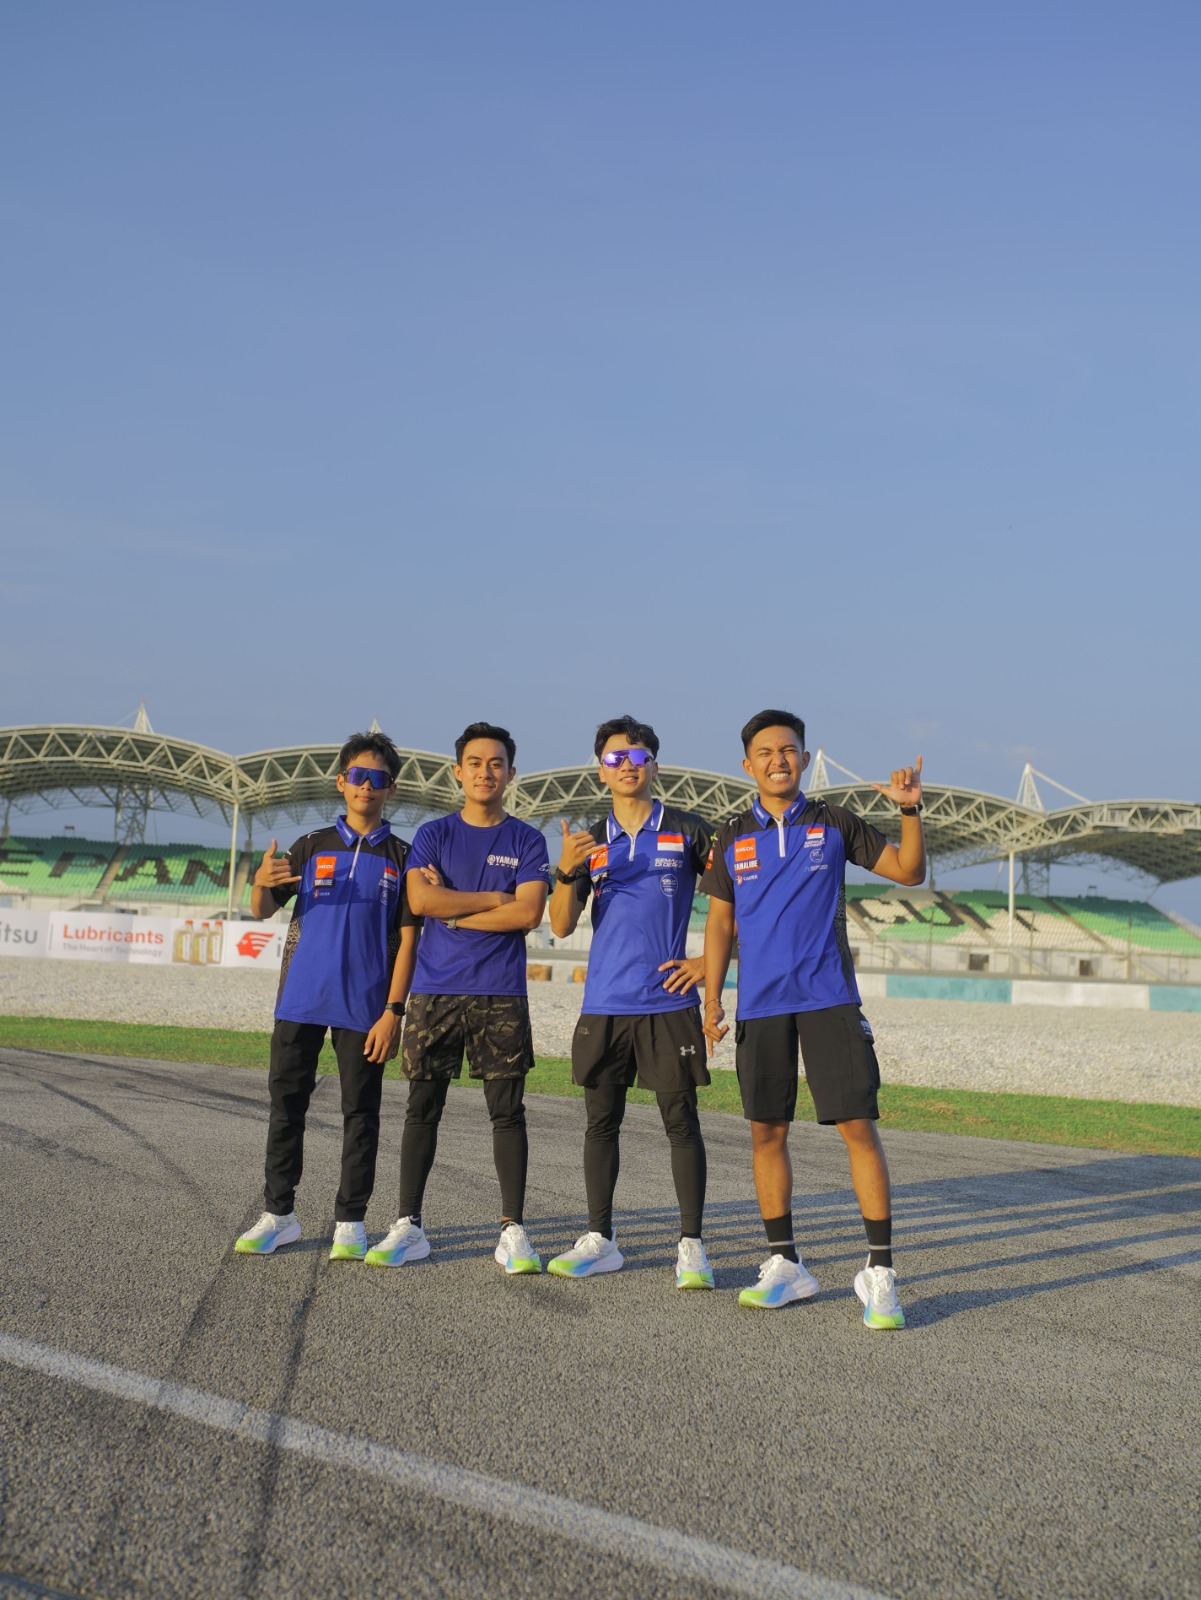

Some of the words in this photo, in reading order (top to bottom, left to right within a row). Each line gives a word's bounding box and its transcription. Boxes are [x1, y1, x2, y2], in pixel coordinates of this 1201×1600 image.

[495, 855, 519, 867] YAMAH
[63, 924, 164, 944] Lubricants
[63, 942, 78, 951] The
[80, 944, 103, 952] Heart
